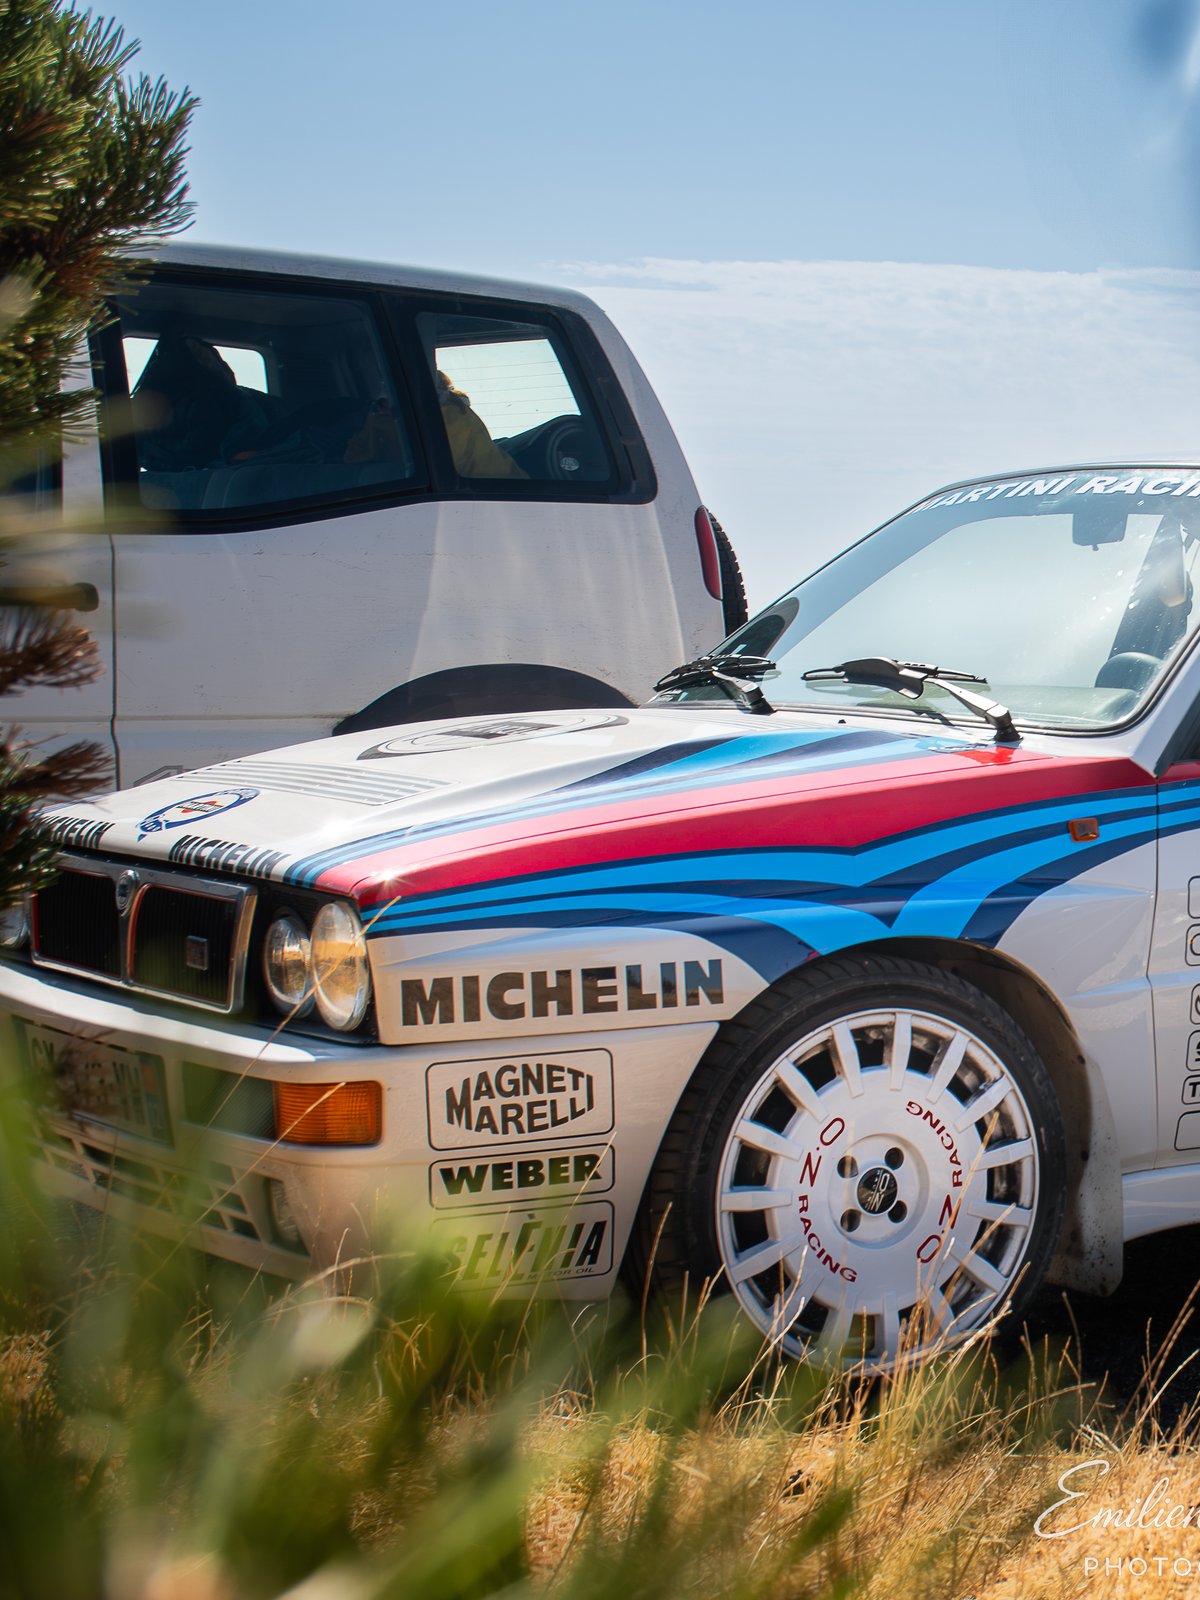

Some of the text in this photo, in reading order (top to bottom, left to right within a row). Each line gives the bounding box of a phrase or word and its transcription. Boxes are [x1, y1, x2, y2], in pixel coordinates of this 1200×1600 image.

[904, 477, 1077, 516] MARTINI
[168, 834, 292, 879] MICHELIN
[401, 959, 724, 1026] MICHELIN
[446, 1063, 594, 1108] MAGNETI
[446, 1089, 594, 1135] MARELLI
[905, 1100, 963, 1188] RACING
[439, 1153, 602, 1196] WEBER
[798, 1195, 857, 1283] RACING
[576, 1267, 595, 1275] OIL
